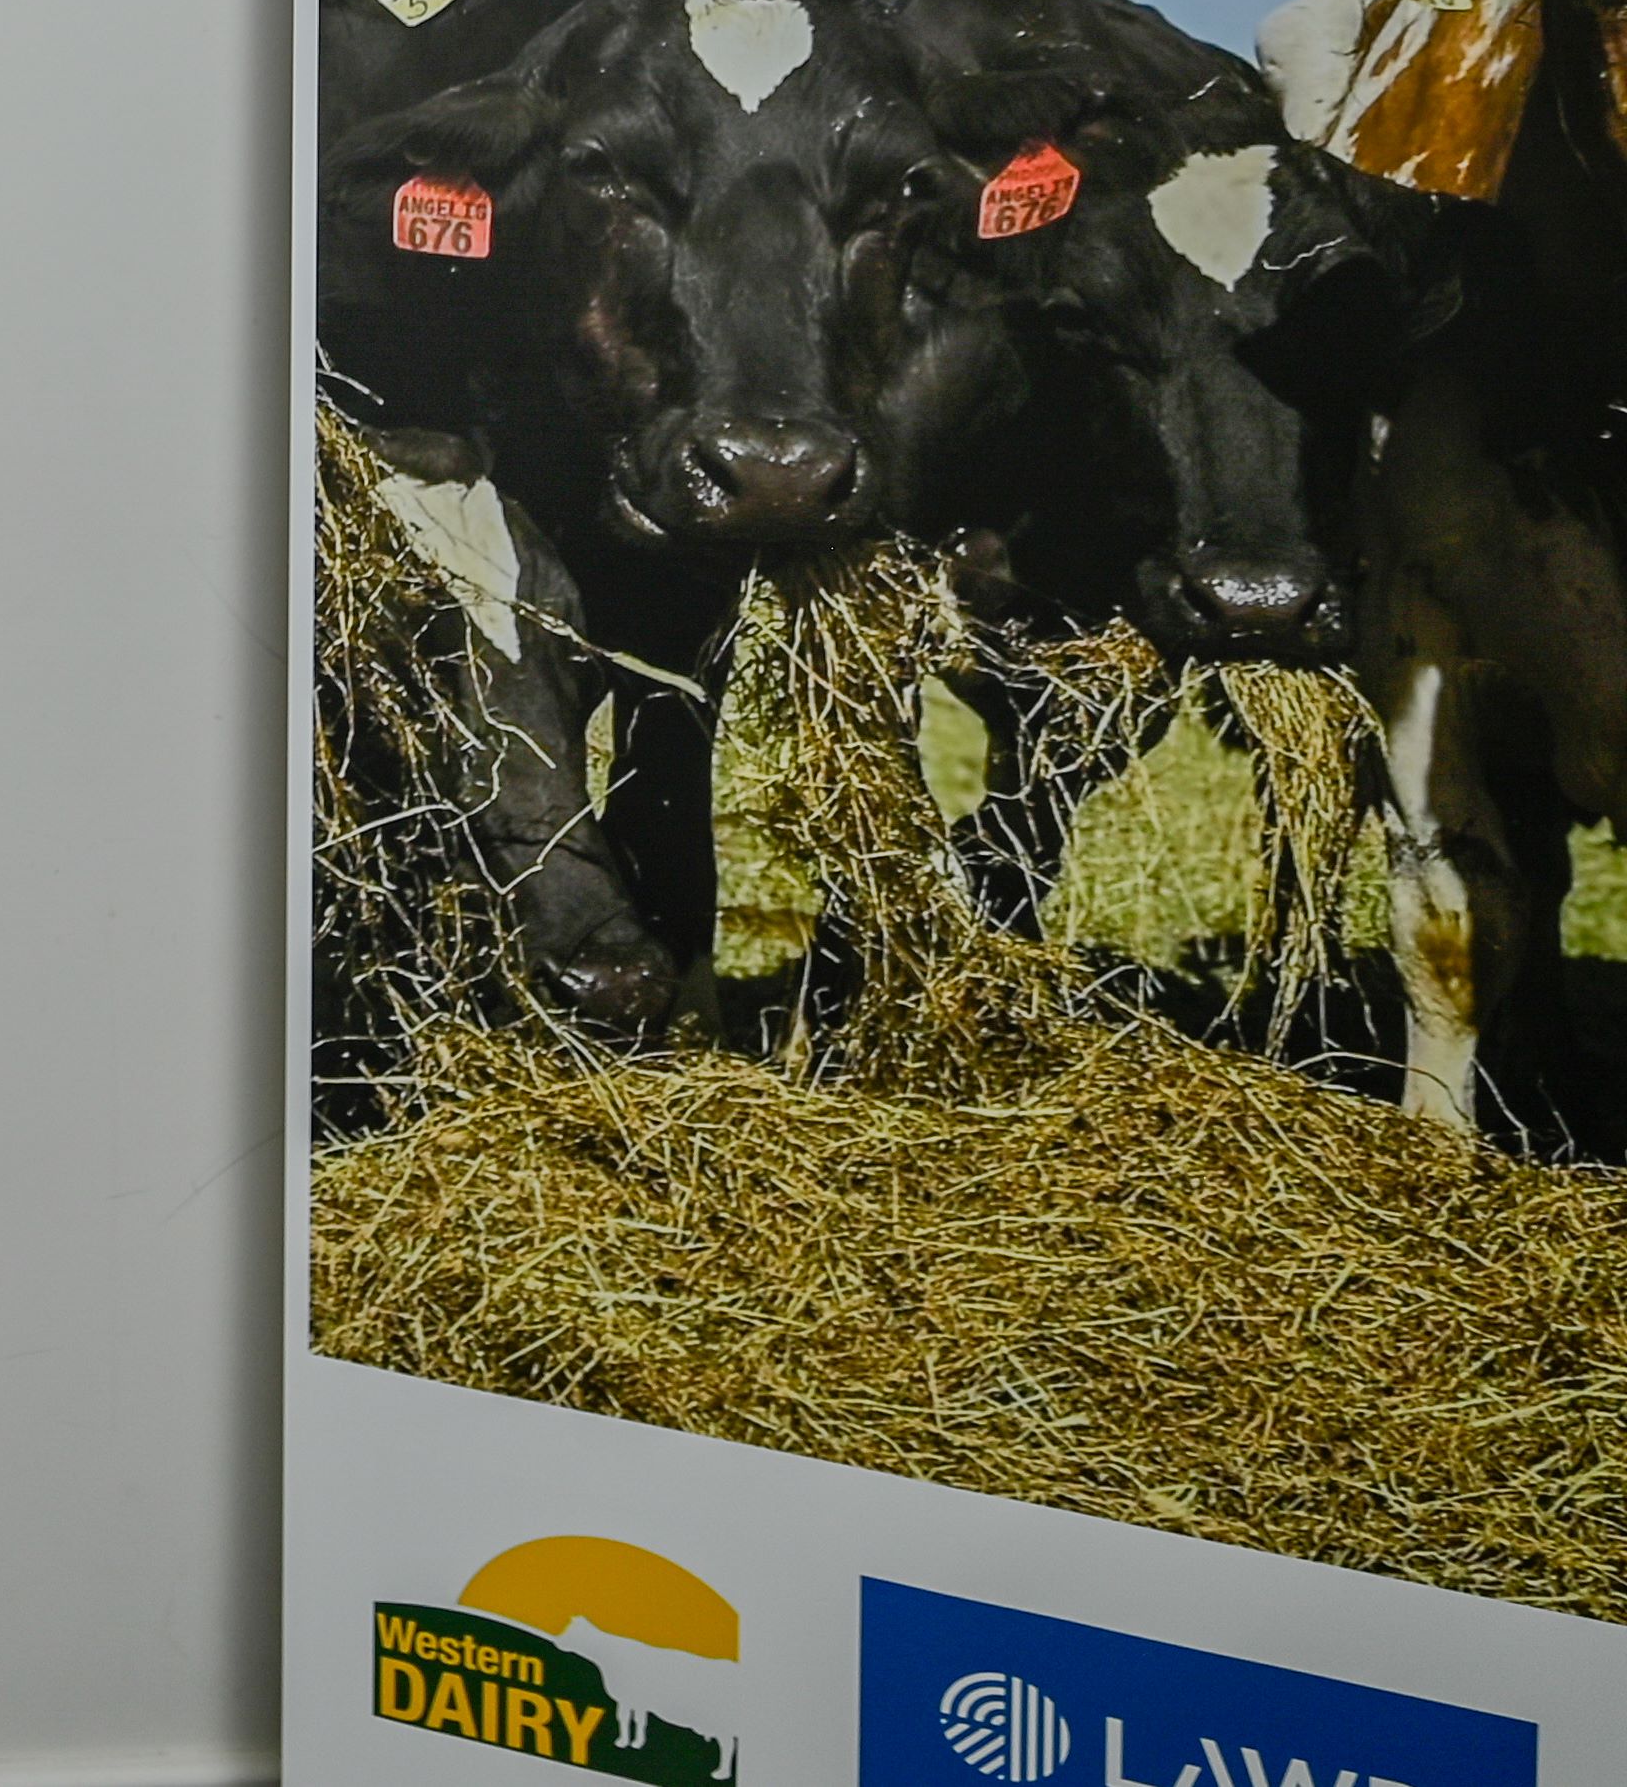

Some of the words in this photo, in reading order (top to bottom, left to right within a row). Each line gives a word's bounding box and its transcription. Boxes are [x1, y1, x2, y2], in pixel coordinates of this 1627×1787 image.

[408, 216, 473, 254] 676
[994, 196, 1061, 234] 676
[376, 1611, 545, 1687] Western
[378, 1655, 606, 1766] DAIRY
[1104, 1715, 1415, 1787] LAW
